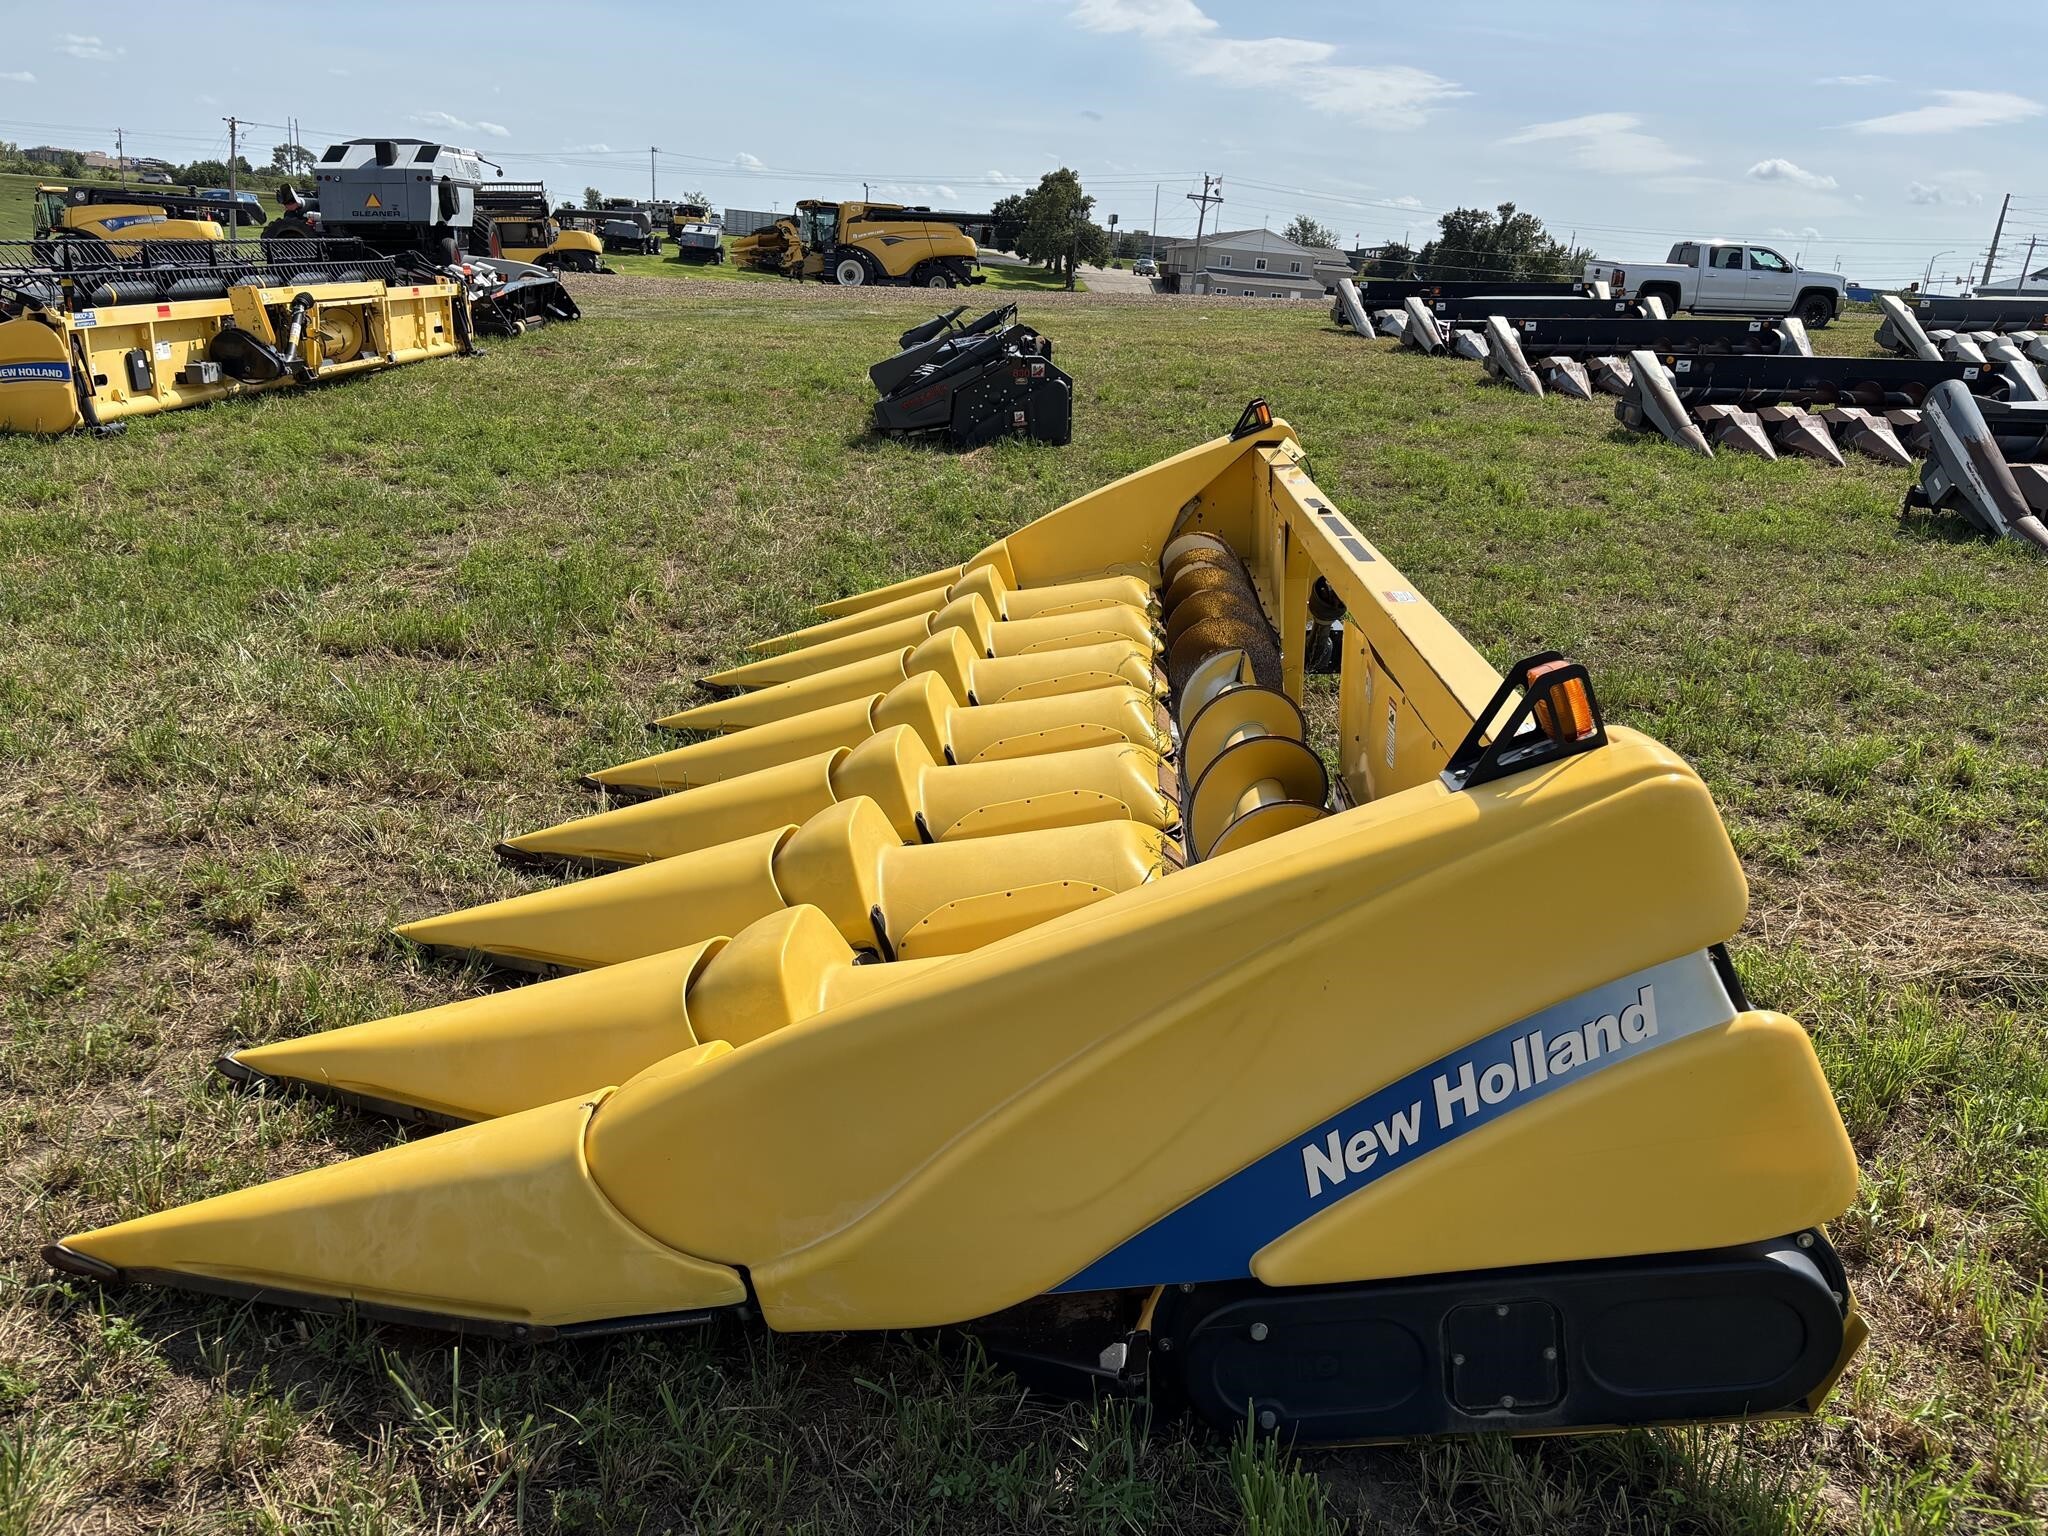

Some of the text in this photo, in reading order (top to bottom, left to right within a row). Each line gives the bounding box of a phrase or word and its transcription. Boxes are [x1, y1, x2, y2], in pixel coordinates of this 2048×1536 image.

[18, 367, 63, 378] HOLLAND
[1301, 983, 1659, 1199] New Holland
